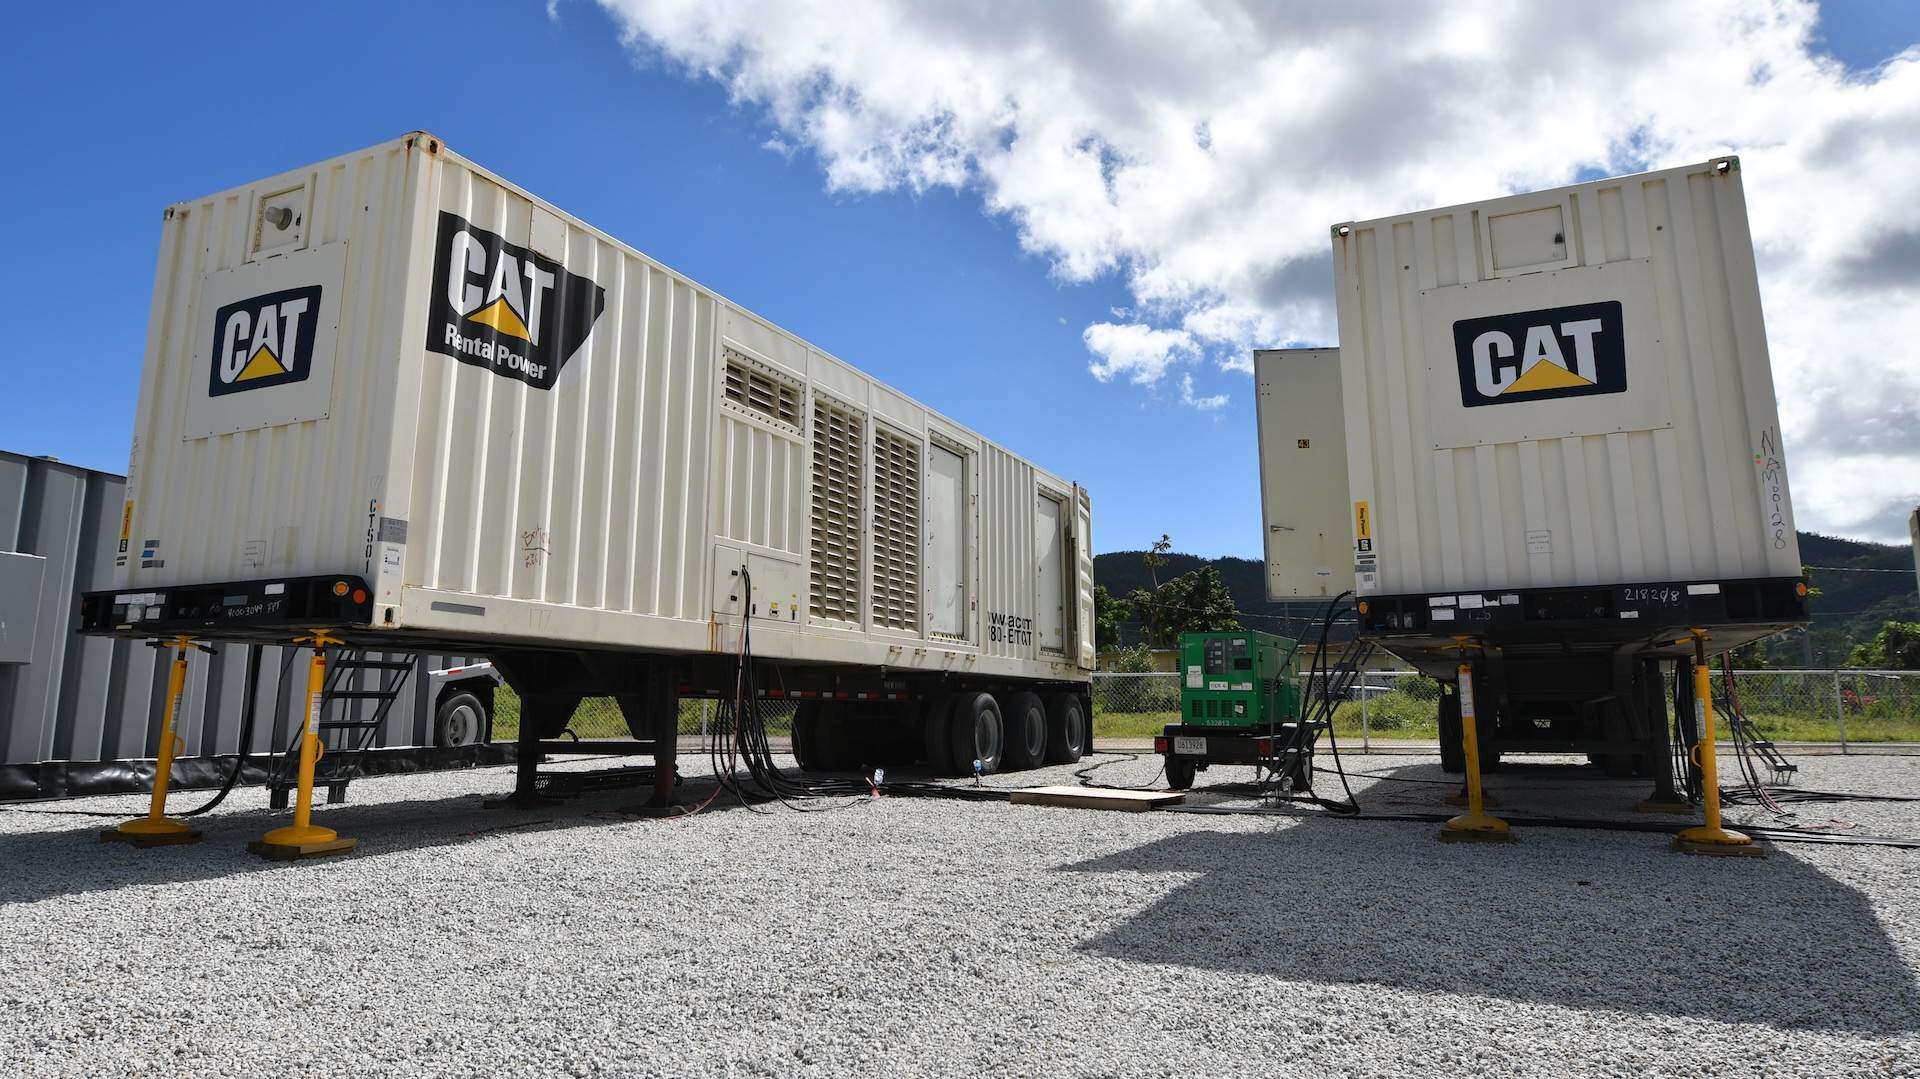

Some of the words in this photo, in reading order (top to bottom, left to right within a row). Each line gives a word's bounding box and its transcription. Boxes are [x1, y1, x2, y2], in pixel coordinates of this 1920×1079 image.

[447, 230, 555, 347] CAT
[219, 297, 309, 384] CAT
[444, 322, 495, 361] Rental
[496, 344, 548, 380] Power
[1472, 318, 1603, 397] CAT
